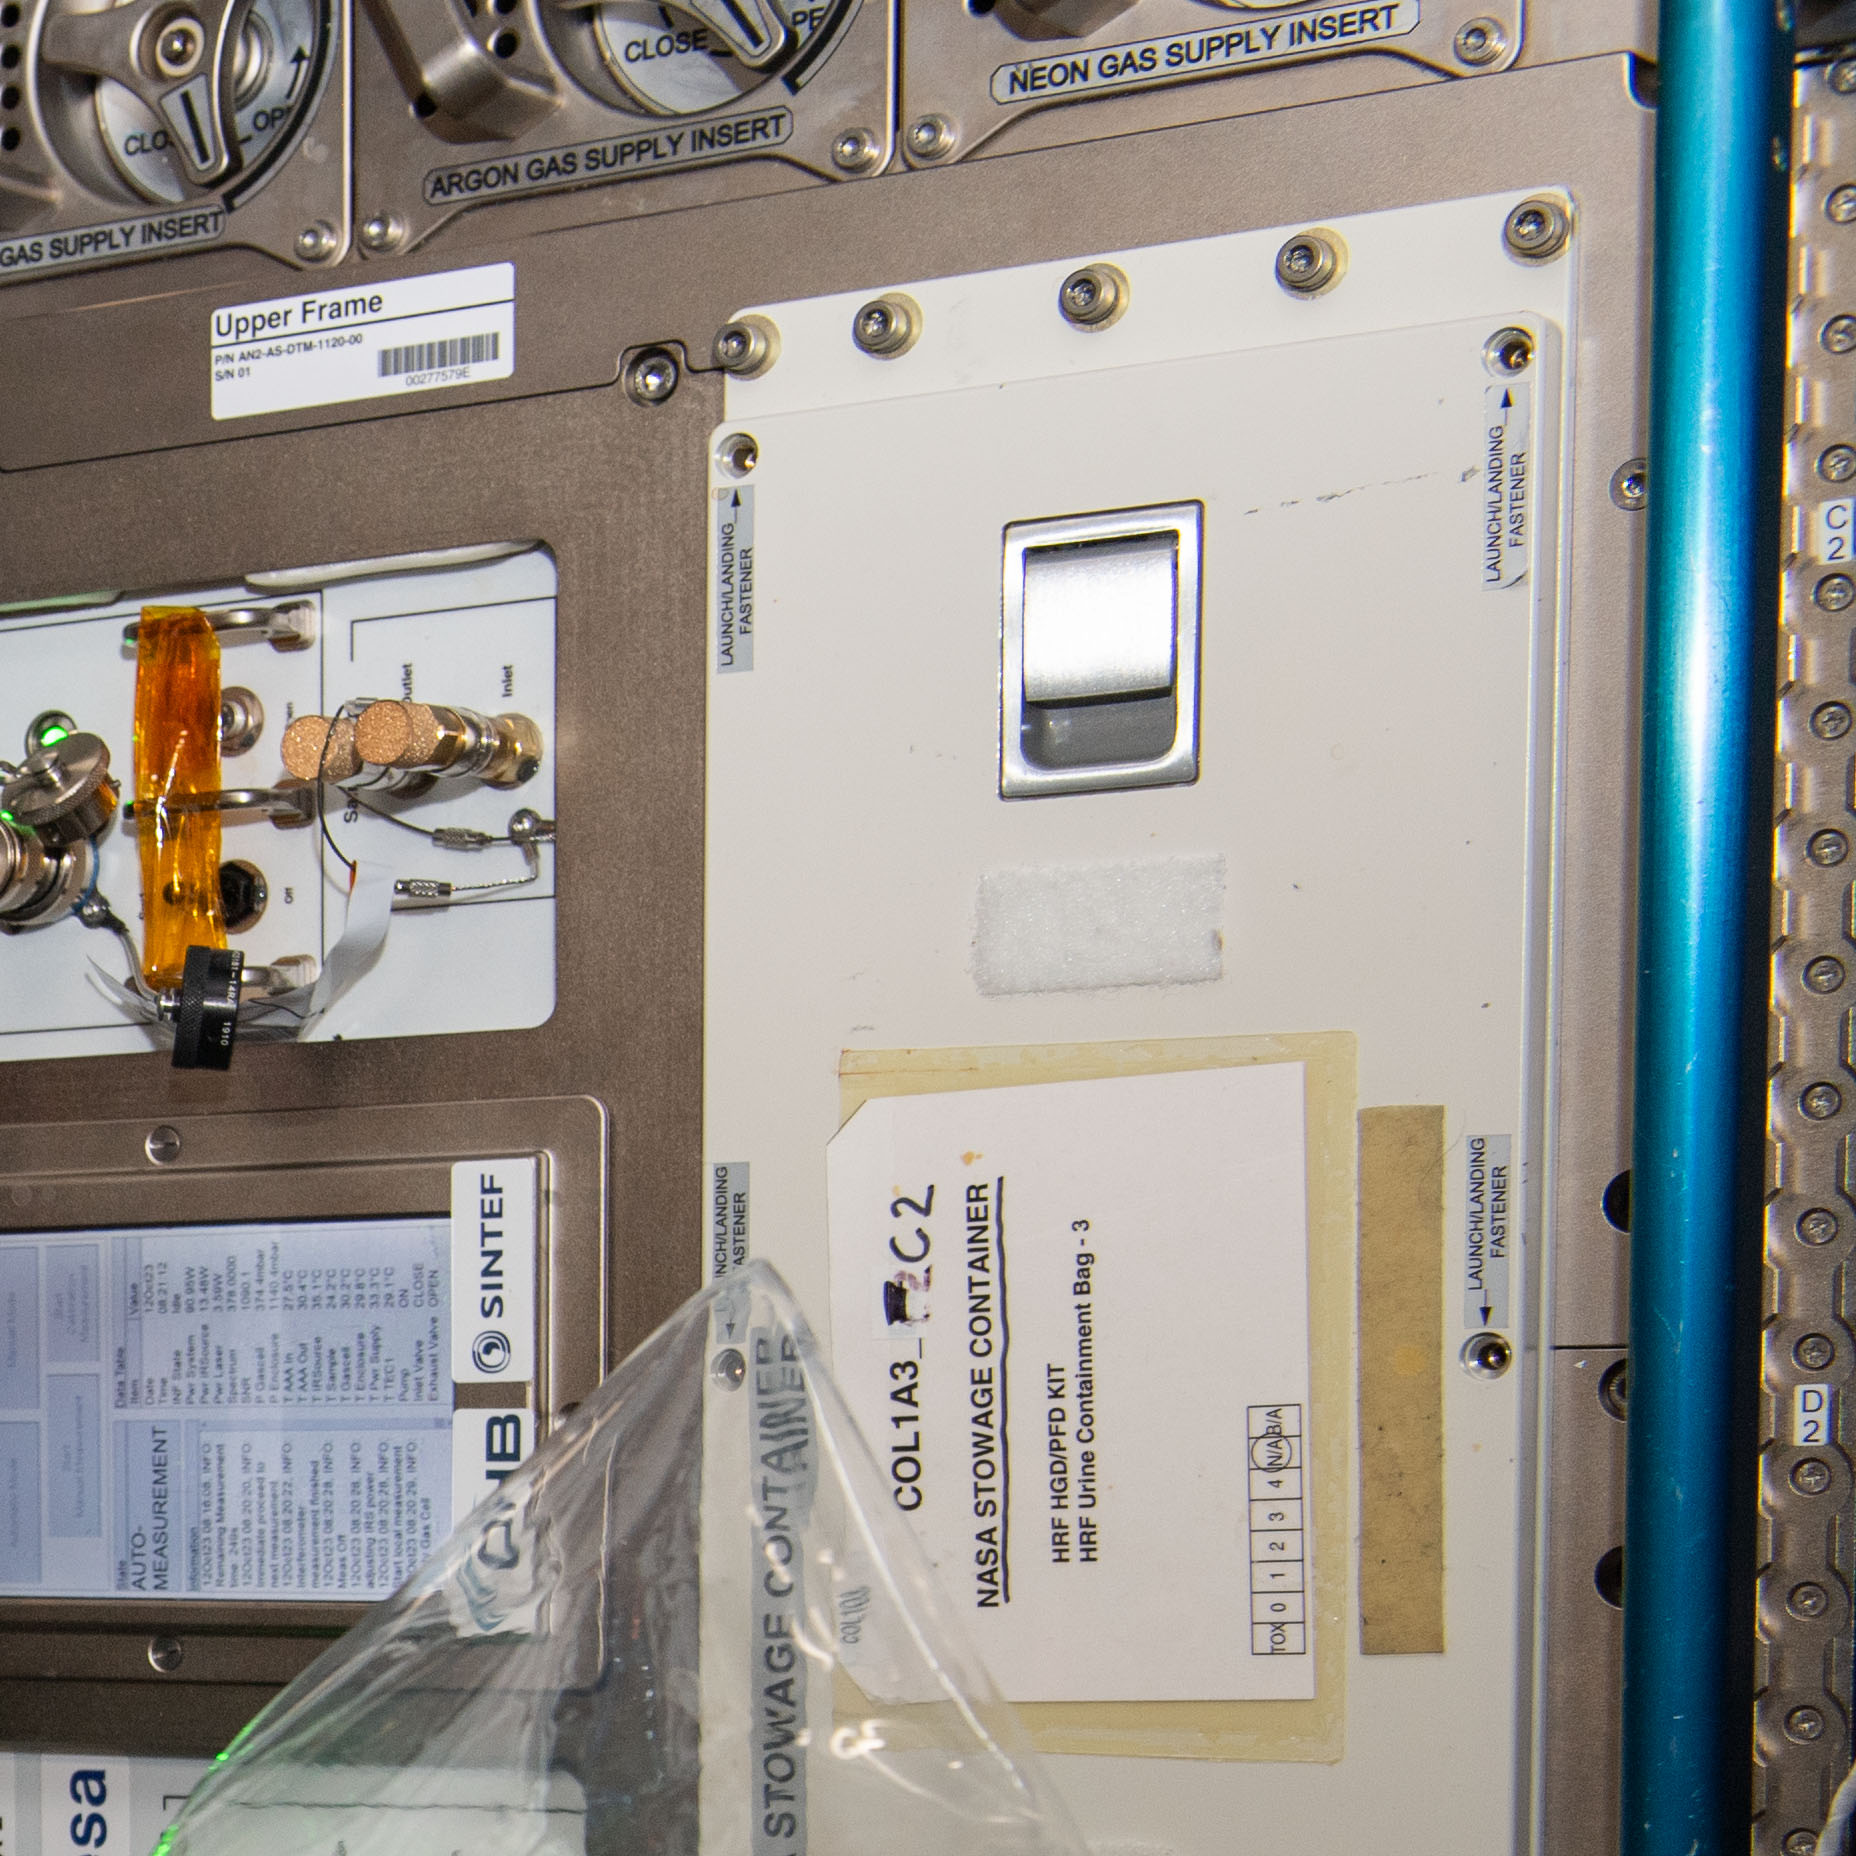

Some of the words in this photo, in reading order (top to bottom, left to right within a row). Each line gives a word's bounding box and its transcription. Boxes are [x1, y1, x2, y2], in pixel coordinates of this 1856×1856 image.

[625, 28, 709, 62] CLOSE
[1009, 59, 1089, 94] NEON
[1098, 46, 1157, 75] GAS
[1165, 25, 1281, 66] SUPPLY
[1289, 4, 1398, 45] INSERT
[430, 164, 518, 198] ARGON
[527, 152, 577, 178] GAS
[584, 133, 684, 170] SUPPLY
[691, 115, 786, 151] INSERT
[49, 225, 135, 259] SUPPLY
[141, 211, 222, 244] INSERT
[216, 307, 292, 340] Upper
[302, 295, 383, 323] Frame
[215, 351, 235, 365] P/N
[238, 333, 363, 361] AN2-AS-DTM-1120-00
[215, 367, 235, 382] S/N
[237, 366, 251, 378] 01
[1486, 425, 1505, 582] LAUNCH/LANDING
[1509, 451, 1527, 548] FASTENER
[1826, 505, 1847, 529] C
[1828, 536, 1845, 561] 2
[721, 523, 734, 666] LAUNCH/LANDING
[740, 547, 753, 634] FASTENER
[501, 665, 513, 697] Inlet
[284, 887, 294, 905] Off
[220, 1022, 232, 1046] 1910
[1072, 1219, 1091, 1232] 3
[1468, 1138, 1485, 1291] LAUNCH/LANDING
[1490, 1165, 1507, 1258] FASTENER
[480, 1174, 504, 1318] SINTEF
[413, 1262, 424, 1308] CLOSE
[428, 1269, 439, 1308] OPEN
[966, 1183, 993, 1357] CONTAINER
[1073, 1253, 1096, 1296] Bag
[398, 1288, 409, 1308] ON
[1047, 1363, 1066, 1399] KIT
[1073, 1302, 1095, 1444] Containment
[1266, 1408, 1283, 1436] B/A
[1802, 1390, 1824, 1412] D
[970, 1368, 997, 1518] STOWAGE
[1269, 1438, 1283, 1467] N/A
[1803, 1420, 1820, 1442] 2
[1047, 1407, 1070, 1510] HGD/PFD
[1076, 1451, 1098, 1509] Urine
[1267, 1480, 1283, 1488] 4
[151, 1425, 168, 1591] MEASUREMENT
[1269, 1512, 1284, 1521] 3
[131, 1525, 147, 1591] AUTO-
[1051, 1517, 1070, 1563] HRF
[1079, 1516, 1098, 1562] HRF
[1269, 1542, 1284, 1551] 2
[976, 1526, 1000, 1608] NASA
[1271, 1603, 1286, 1612] 0
[1270, 1623, 1286, 1653] TOX
[762, 1613, 797, 1839] STOWAGE
